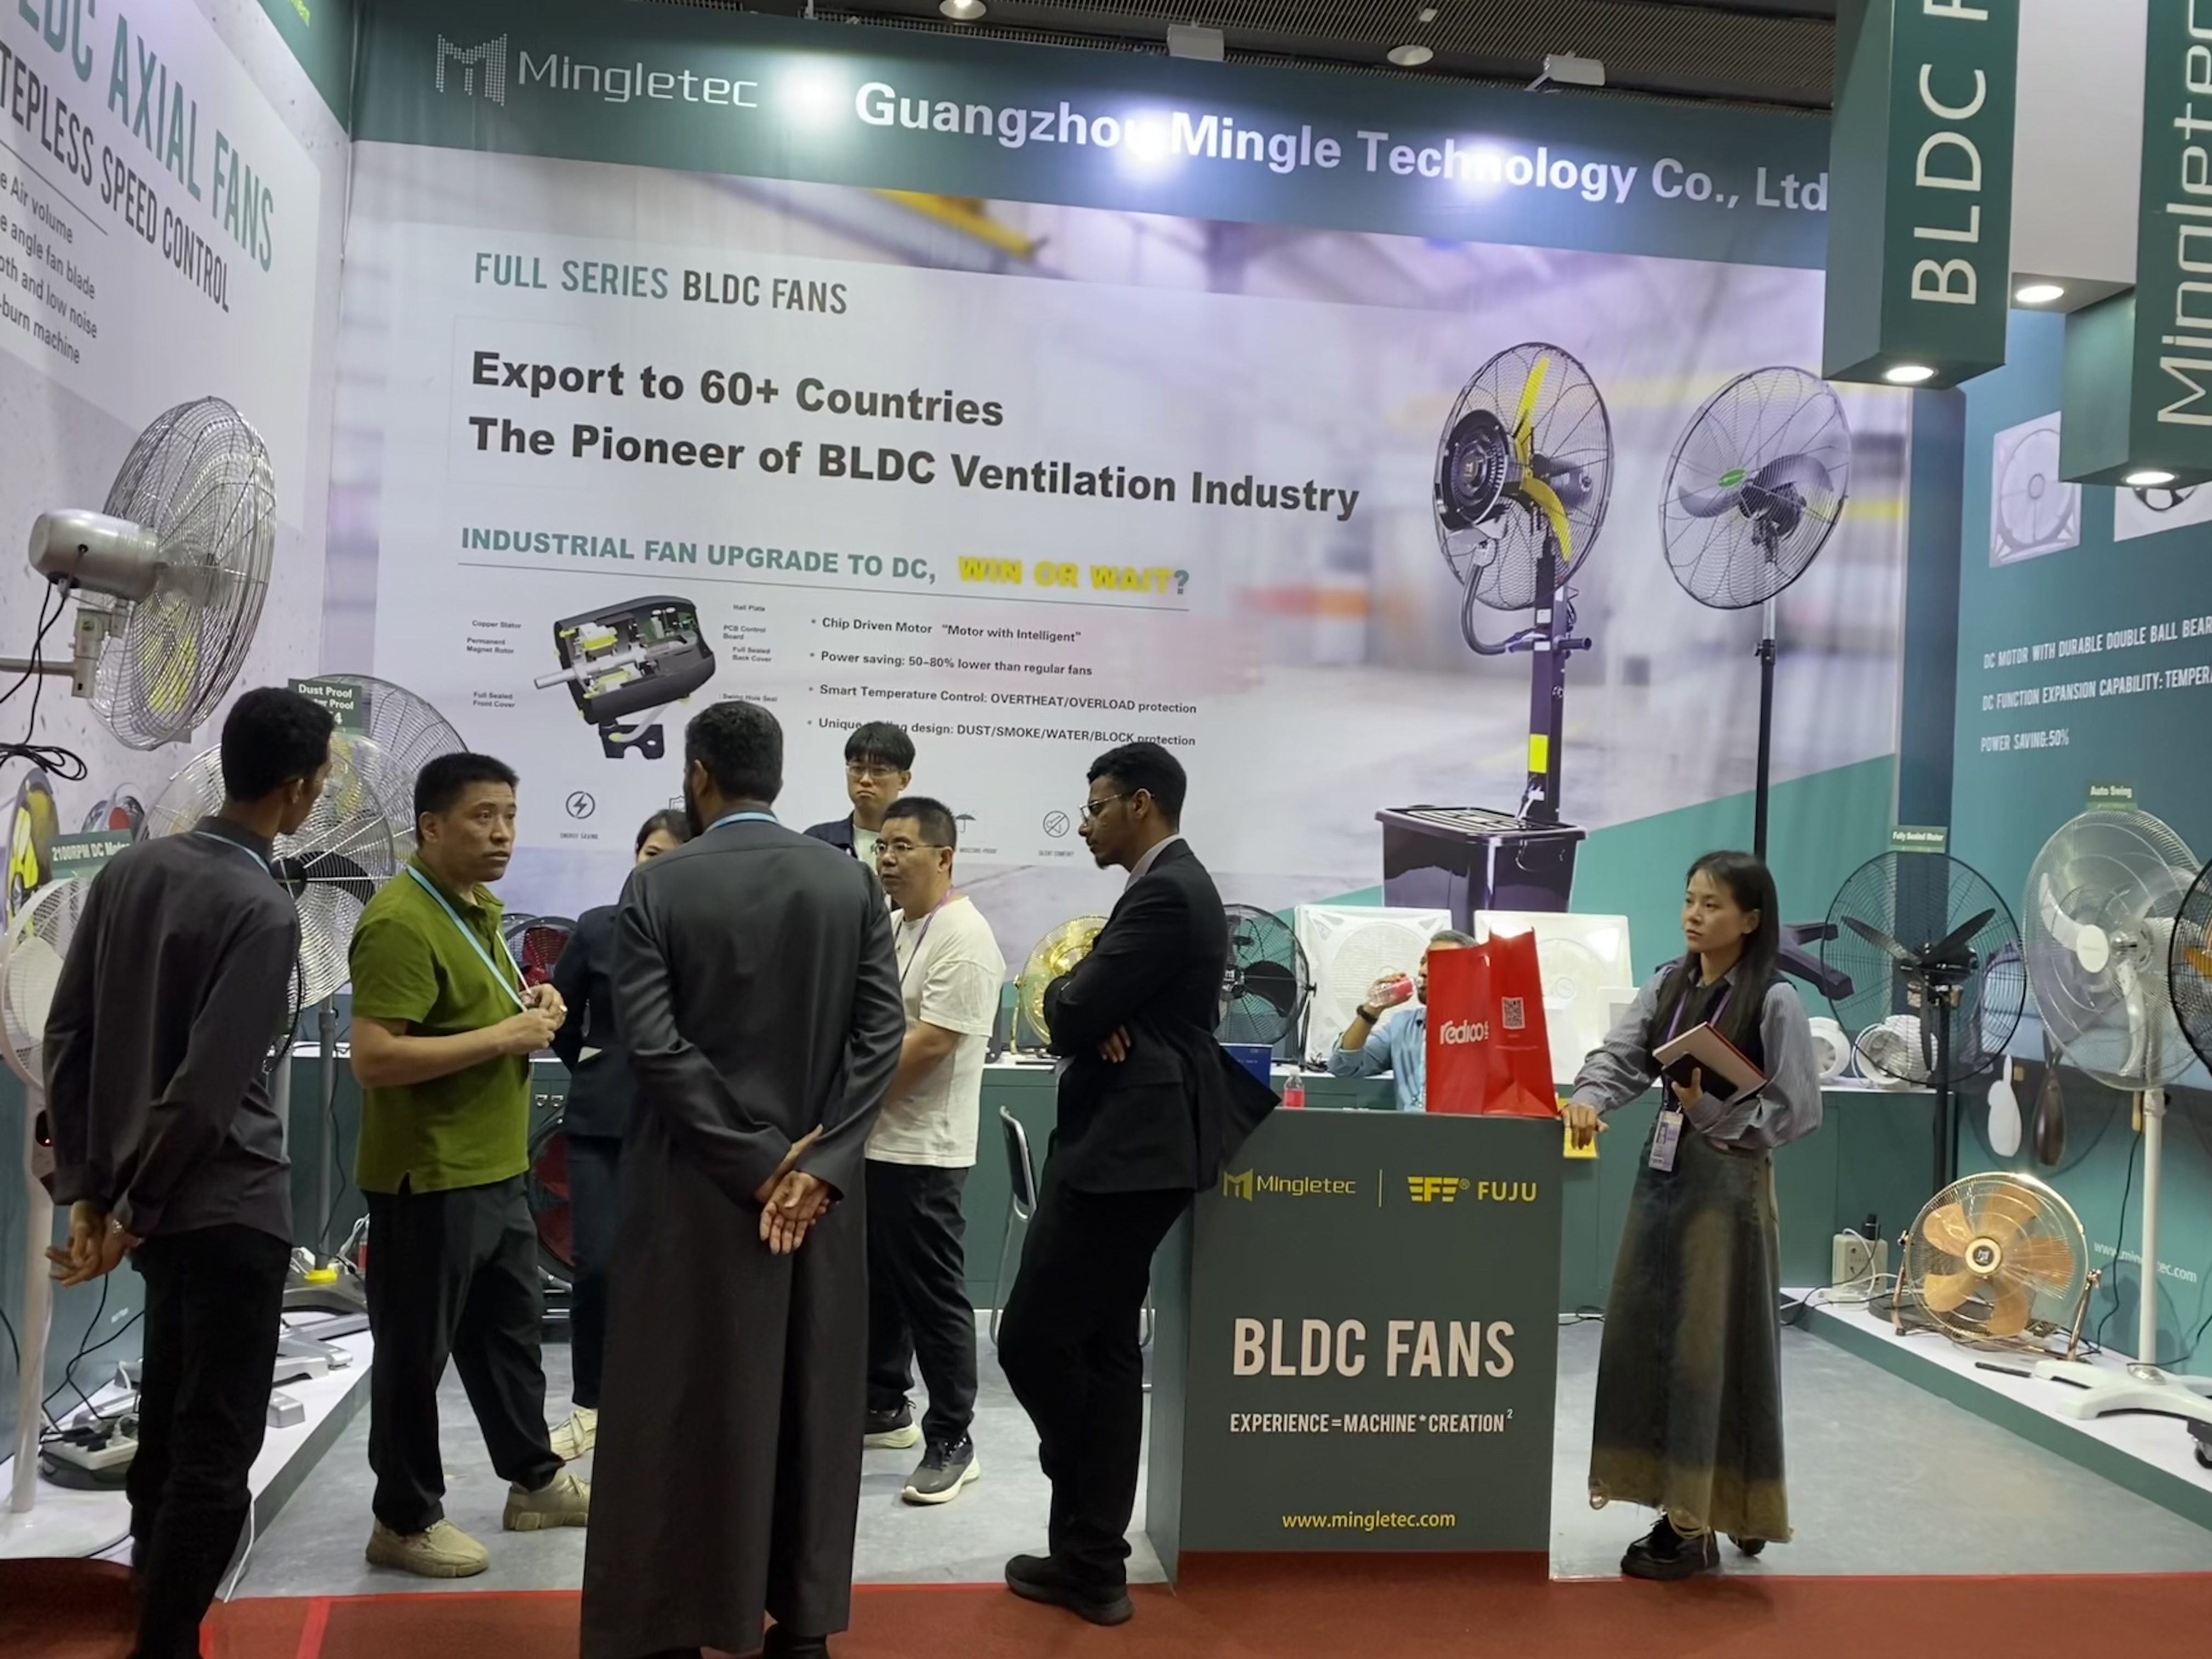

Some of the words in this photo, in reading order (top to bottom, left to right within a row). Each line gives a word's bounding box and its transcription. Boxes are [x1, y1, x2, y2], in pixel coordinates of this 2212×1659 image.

[518, 50, 758, 108] Mingletec
[108, 13, 201, 202] AXIAL
[212, 129, 273, 273] FANS
[1171, 111, 1341, 174] Mingle
[1357, 129, 1638, 204] Technology
[1652, 157, 1740, 209] Co.,
[1756, 167, 1829, 212] Ltd
[1911, 63, 1987, 305] BLDC
[10, 176, 28, 207] Air
[31, 196, 73, 244] volume
[100, 145, 158, 245] SPEED
[162, 206, 229, 313] CONTROL
[11, 223, 42, 259] angle
[46, 245, 63, 276] fan
[66, 261, 95, 300] blade
[475, 252, 548, 289] FULL
[561, 259, 669, 300] SERIES
[682, 269, 760, 307] BLDC
[771, 278, 848, 315] FANS
[21, 272, 43, 301] and
[47, 284, 66, 317] low
[70, 307, 97, 338] noise
[33, 321, 80, 364] machine
[472, 350, 624, 398] Export
[640, 365, 684, 400] to
[700, 370, 779, 406] 60+
[795, 377, 1004, 427] Countries
[469, 416, 555, 455] The
[572, 424, 745, 470] Pioneer
[758, 441, 803, 474] of
[819, 443, 935, 485] BLDC
[950, 453, 1175, 502] Ventilation
[1192, 471, 1360, 522] Industry
[462, 527, 635, 560] INDUSTRIAL
[645, 539, 697, 564] FAN
[707, 544, 839, 573] UPGRADE
[848, 554, 883, 576] TO
[892, 557, 935, 585] DC,
[958, 556, 1022, 585] WIN
[1034, 561, 1080, 589] OR
[472, 620, 498, 628] Copper
[822, 617, 849, 630] Chip
[853, 619, 892, 631] Driven
[895, 622, 933, 633] Motor
[988, 629, 1014, 639] with
[1984, 652, 1995, 669] DC
[1998, 647, 2028, 667] MOTOR
[2032, 642, 2056, 662] WITH
[2058, 634, 2103, 657] DURABLE
[2106, 627, 2147, 650] DOUBLE
[2150, 622, 2178, 643] BALL
[821, 651, 859, 663] Power
[864, 654, 905, 667] saving:
[958, 659, 991, 670] lower
[995, 661, 1020, 672] than
[1024, 664, 1064, 675] regular
[1068, 665, 1093, 675] fans
[298, 684, 323, 695] Dust
[325, 686, 352, 698] Proof
[329, 699, 353, 710] Proof
[820, 684, 857, 696] Smart
[861, 686, 937, 700] Temperature
[940, 690, 987, 703] Control:
[991, 693, 1135, 710] OVERTHEAT/OVERLOAD
[1138, 702, 1197, 713] protection
[1982, 695, 1994, 711] DC
[1996, 688, 2040, 709] FUNCTION
[2042, 680, 2096, 704] EXPANSION
[2099, 672, 2163, 696] CAPABILITY:
[2165, 665, 2212, 689] TEMPER
[819, 718, 862, 731] Unique
[912, 723, 953, 736] design:
[1137, 735, 1196, 746] protection
[1981, 735, 2010, 753] POWER
[2090, 785, 2109, 797] Auto
[2110, 785, 2132, 798] Swing
[91, 843, 104, 857] DC
[1257, 1175, 1356, 1196] Mingletec
[1477, 1182, 1537, 1202] FUJU
[1233, 1318, 1367, 1377] BLDC
[1387, 1320, 1515, 1378] FANS
[1282, 1510, 1456, 1532] www.mingletec.com
